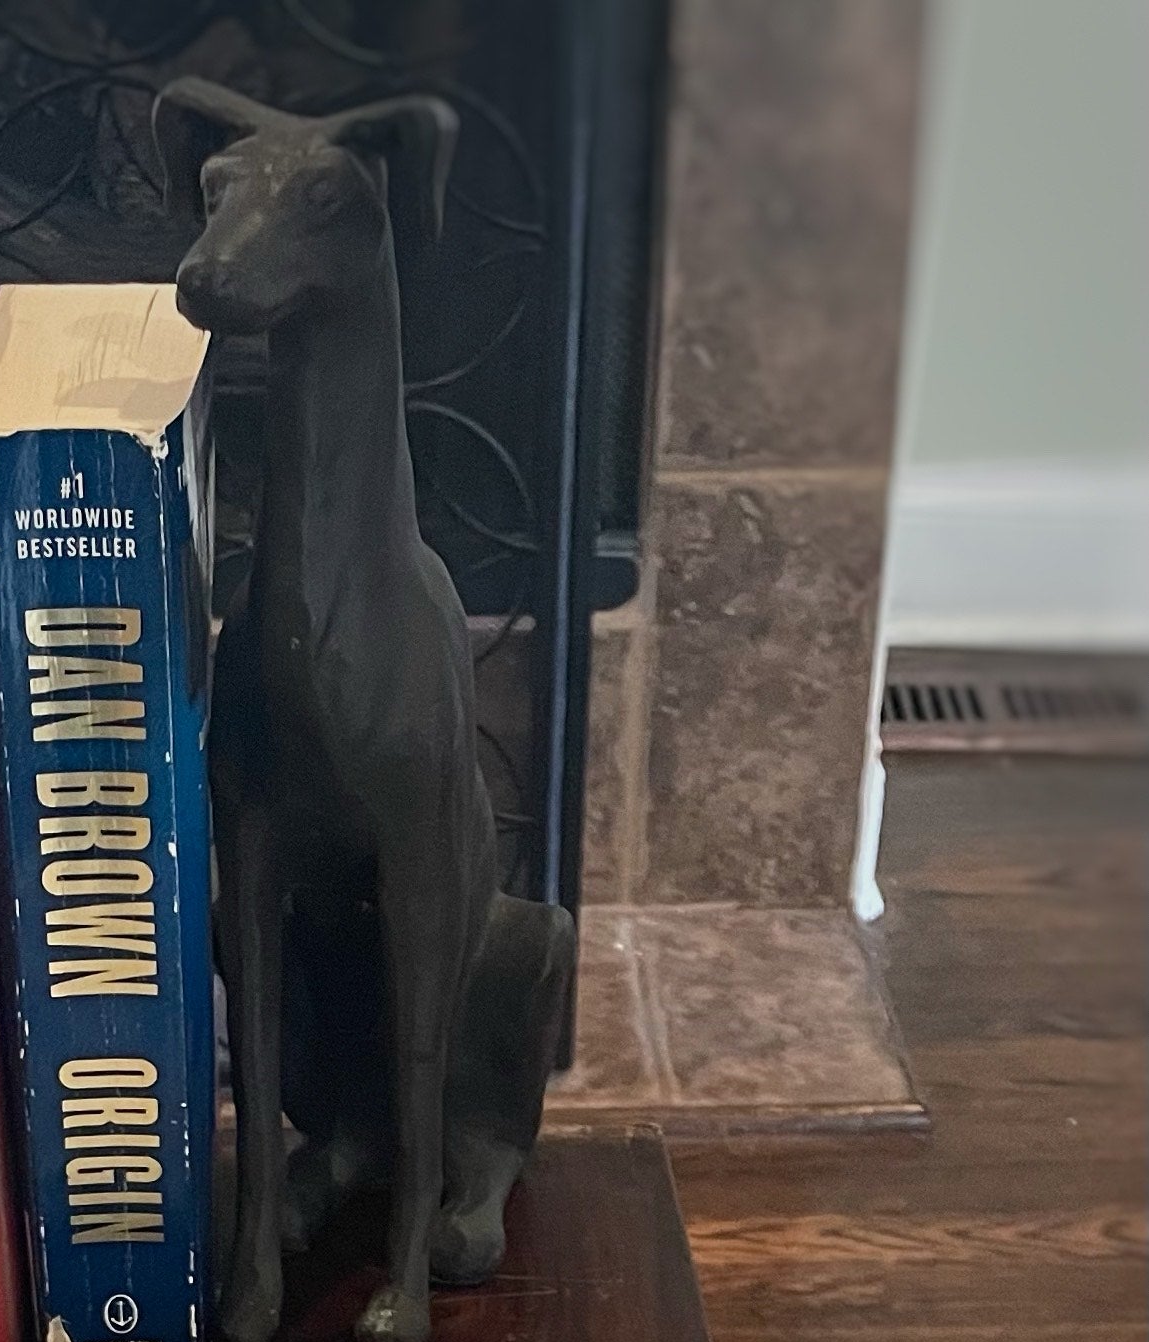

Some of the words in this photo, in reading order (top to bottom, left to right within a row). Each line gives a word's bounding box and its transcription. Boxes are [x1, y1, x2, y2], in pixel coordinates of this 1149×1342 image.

[15, 508, 135, 530] WORLDWIDE
[60, 473, 84, 498] #1
[17, 537, 137, 560] BESTSELLER
[25, 608, 146, 742] DAN
[37, 773, 158, 997] BROWN
[59, 1059, 164, 1244] ORIGIN
